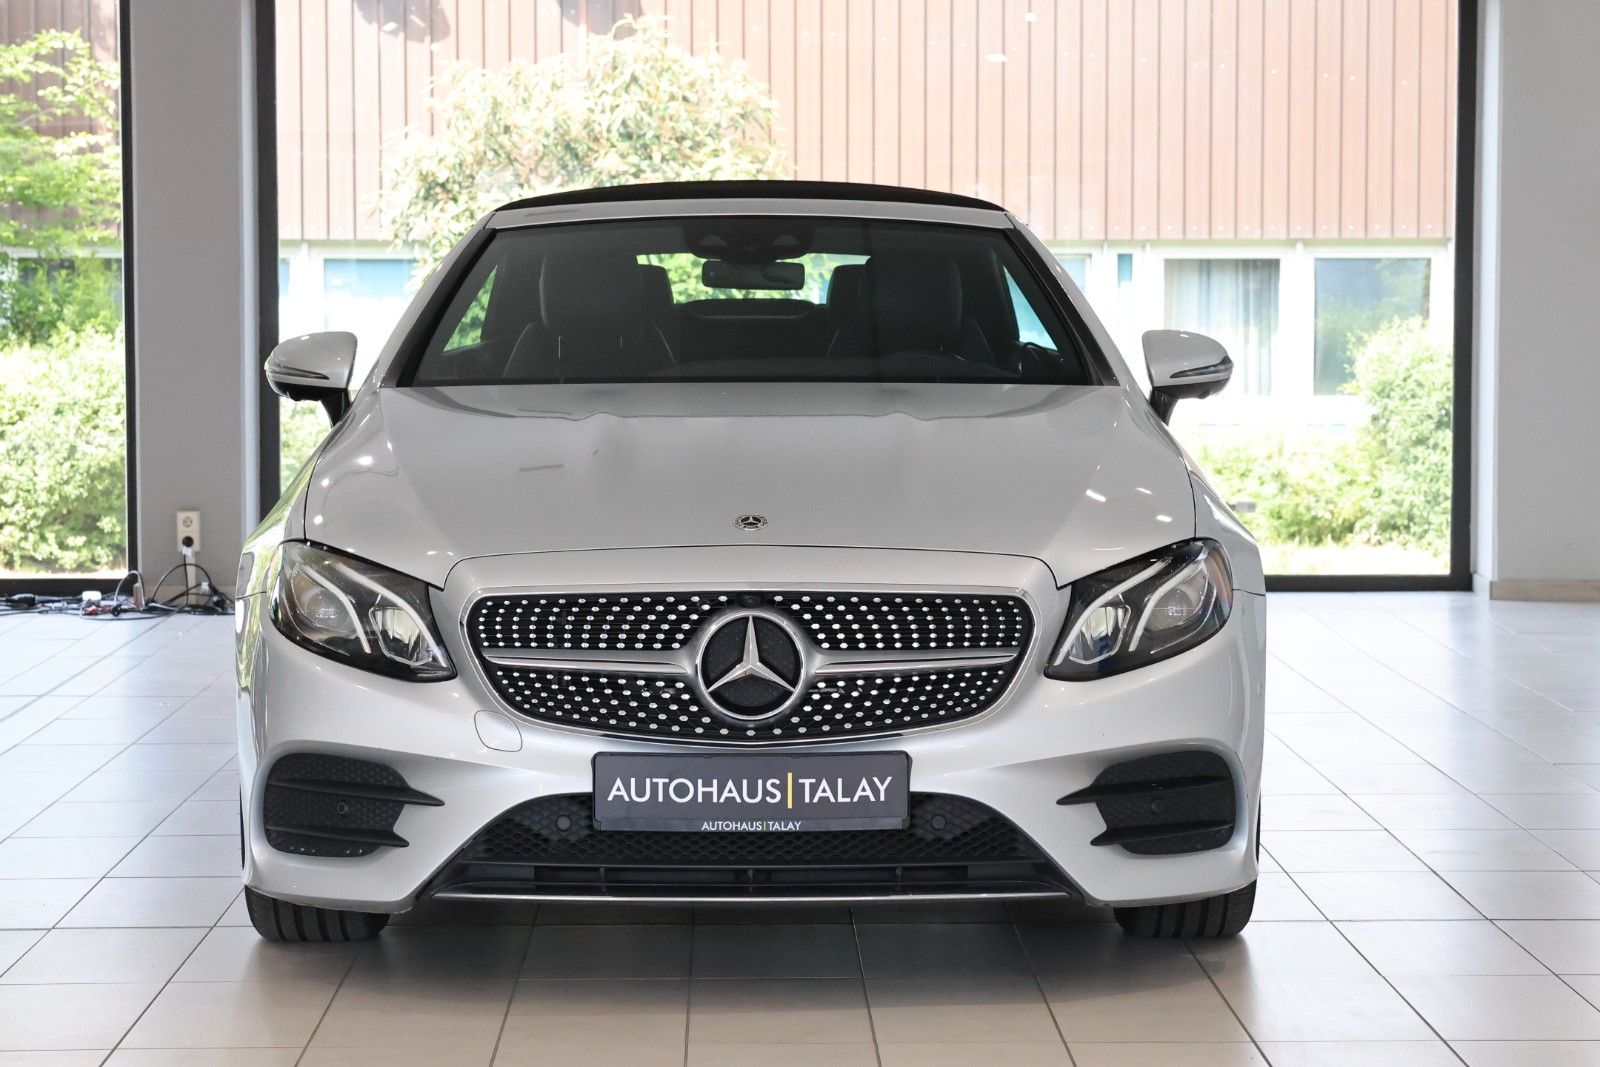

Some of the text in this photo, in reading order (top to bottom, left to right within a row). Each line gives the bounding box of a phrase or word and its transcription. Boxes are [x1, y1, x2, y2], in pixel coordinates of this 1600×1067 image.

[607, 776, 893, 803] AUTOHAUS TALAY
[701, 821, 802, 831] AUTOHAUS TALAY
